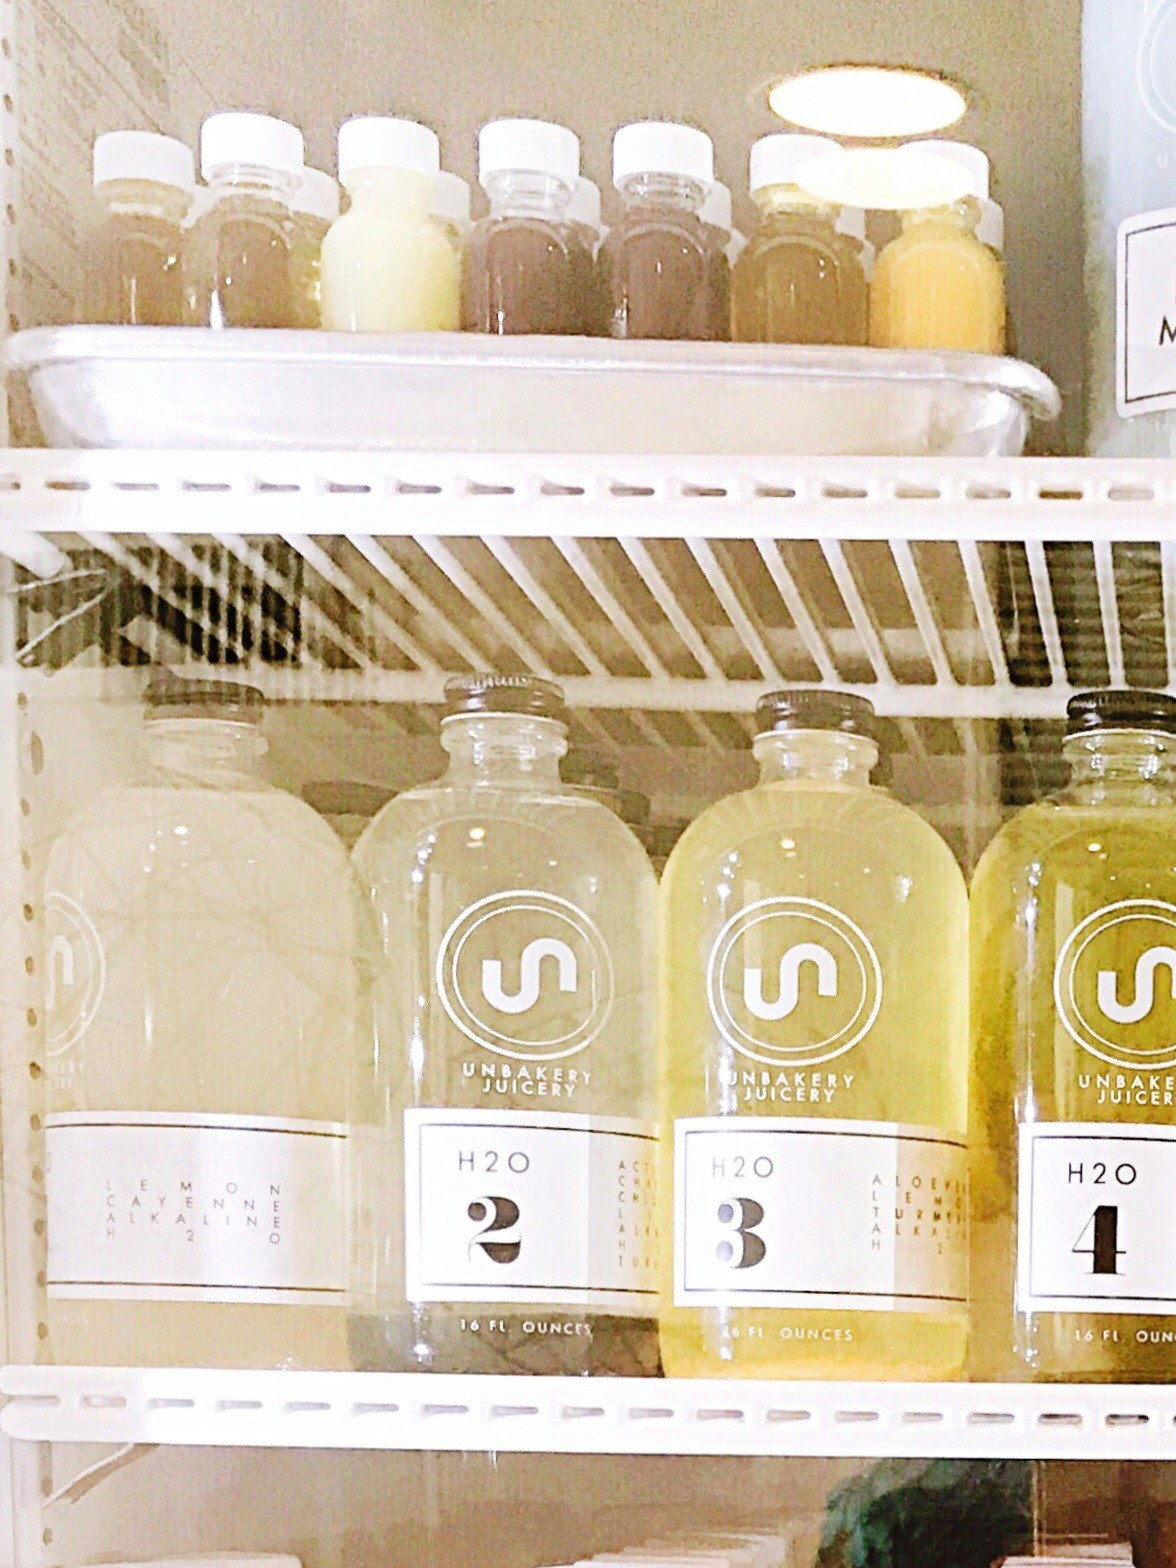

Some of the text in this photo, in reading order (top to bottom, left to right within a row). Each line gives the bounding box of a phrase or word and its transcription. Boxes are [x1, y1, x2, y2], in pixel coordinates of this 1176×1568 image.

[462, 1062, 592, 1085] UNBAKERY
[483, 1080, 576, 1097] JUICERY
[744, 1087, 836, 1103] JUICERY
[458, 1150, 530, 1174] H2O
[712, 1155, 774, 1179] H2O
[1068, 1162, 1137, 1185] H2O
[106, 1195, 281, 1212] CAYENNE
[106, 1212, 281, 1228] ALKALINE
[467, 1195, 522, 1264] 2
[716, 1197, 767, 1269] 3
[1072, 1204, 1127, 1276] 4
[460, 1319, 480, 1332] 16
[522, 1320, 593, 1336] OUNCES
[780, 1327, 853, 1341] OUNCES
[1074, 1329, 1093, 1342] 16
